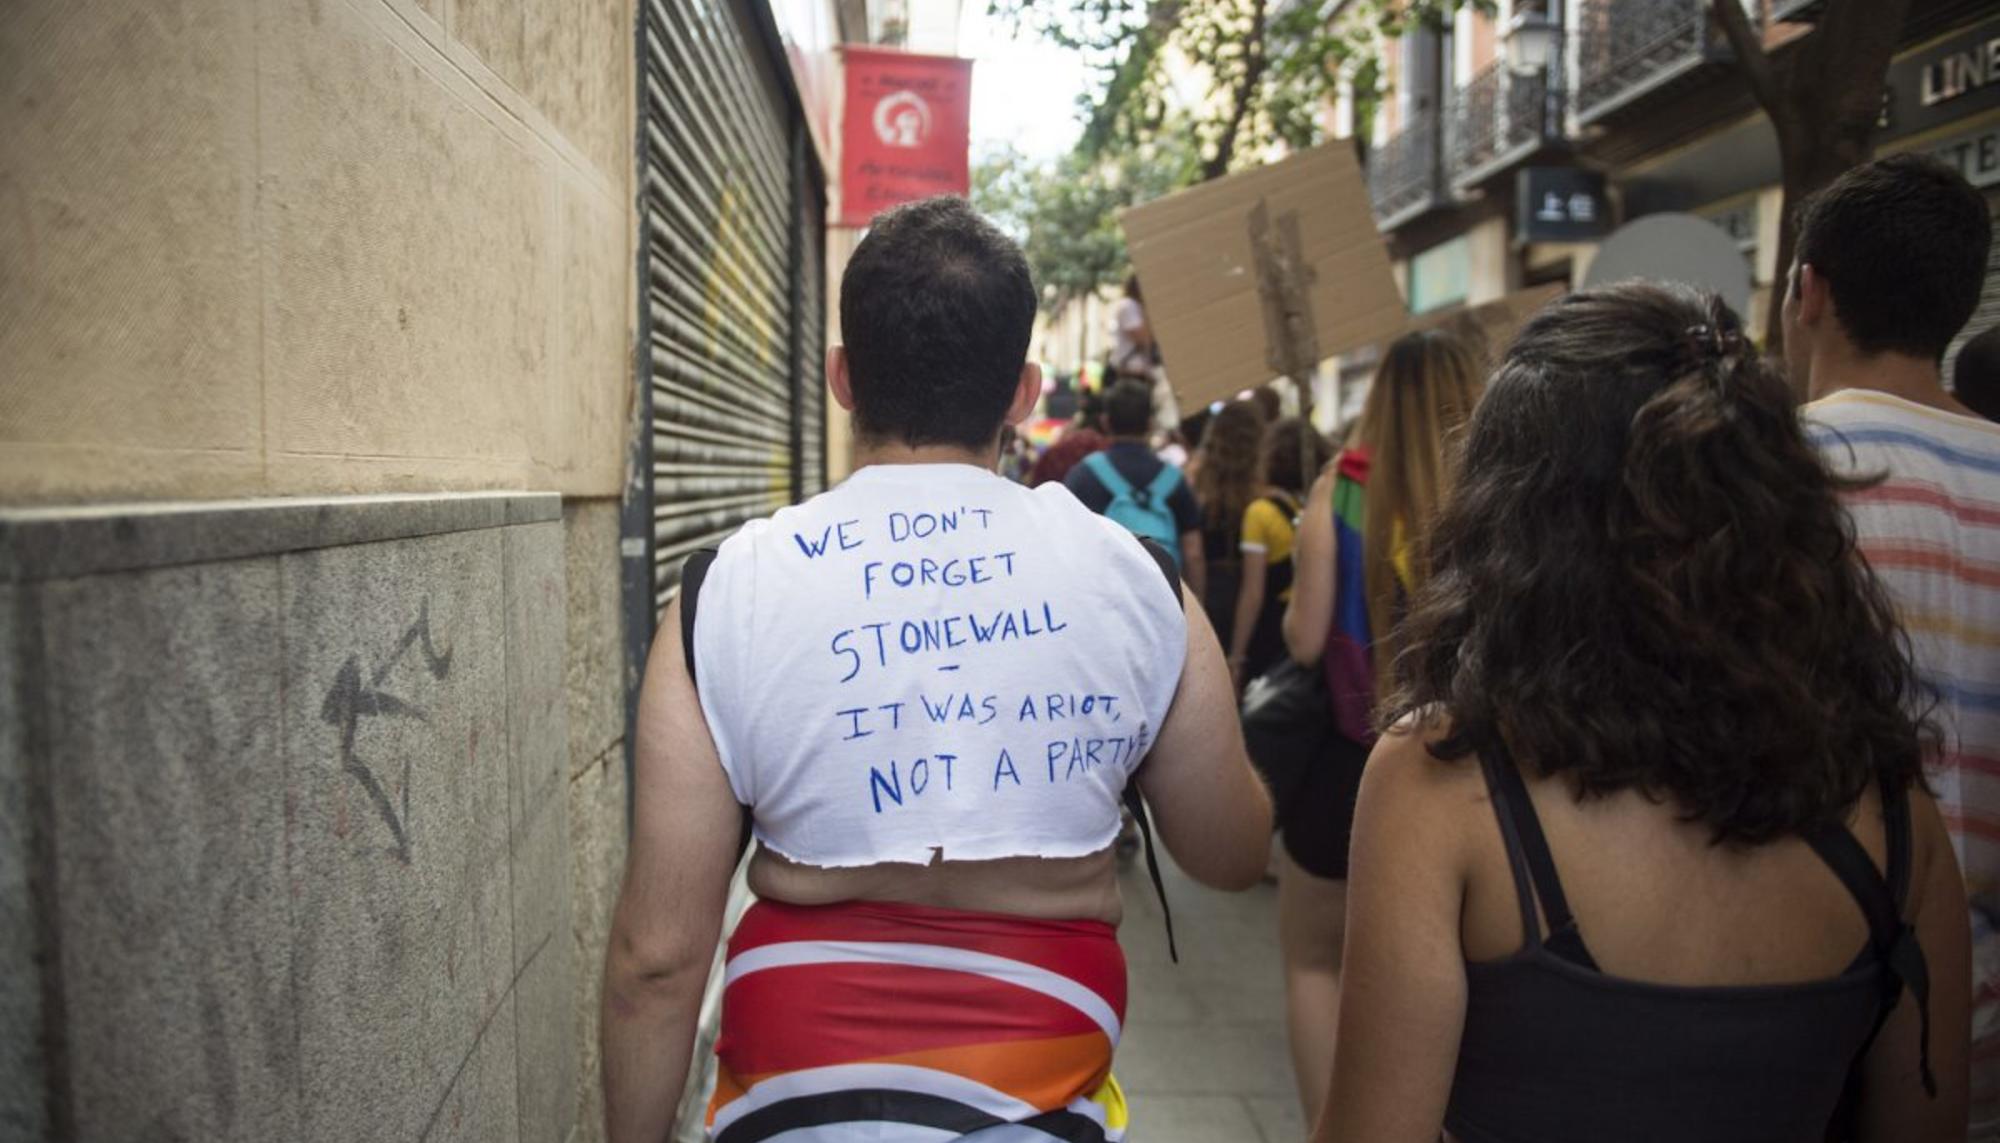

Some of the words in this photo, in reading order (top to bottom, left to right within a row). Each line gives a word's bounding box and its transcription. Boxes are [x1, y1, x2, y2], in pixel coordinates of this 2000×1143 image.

[794, 519, 862, 559] WE
[889, 507, 993, 542] DON'T
[864, 552, 1016, 599] FORGET
[831, 602, 1067, 683] STONEWALL
[836, 704, 905, 741] IT
[920, 694, 998, 726] WAS
[869, 754, 958, 813] NOT
[993, 748, 1021, 790] A
